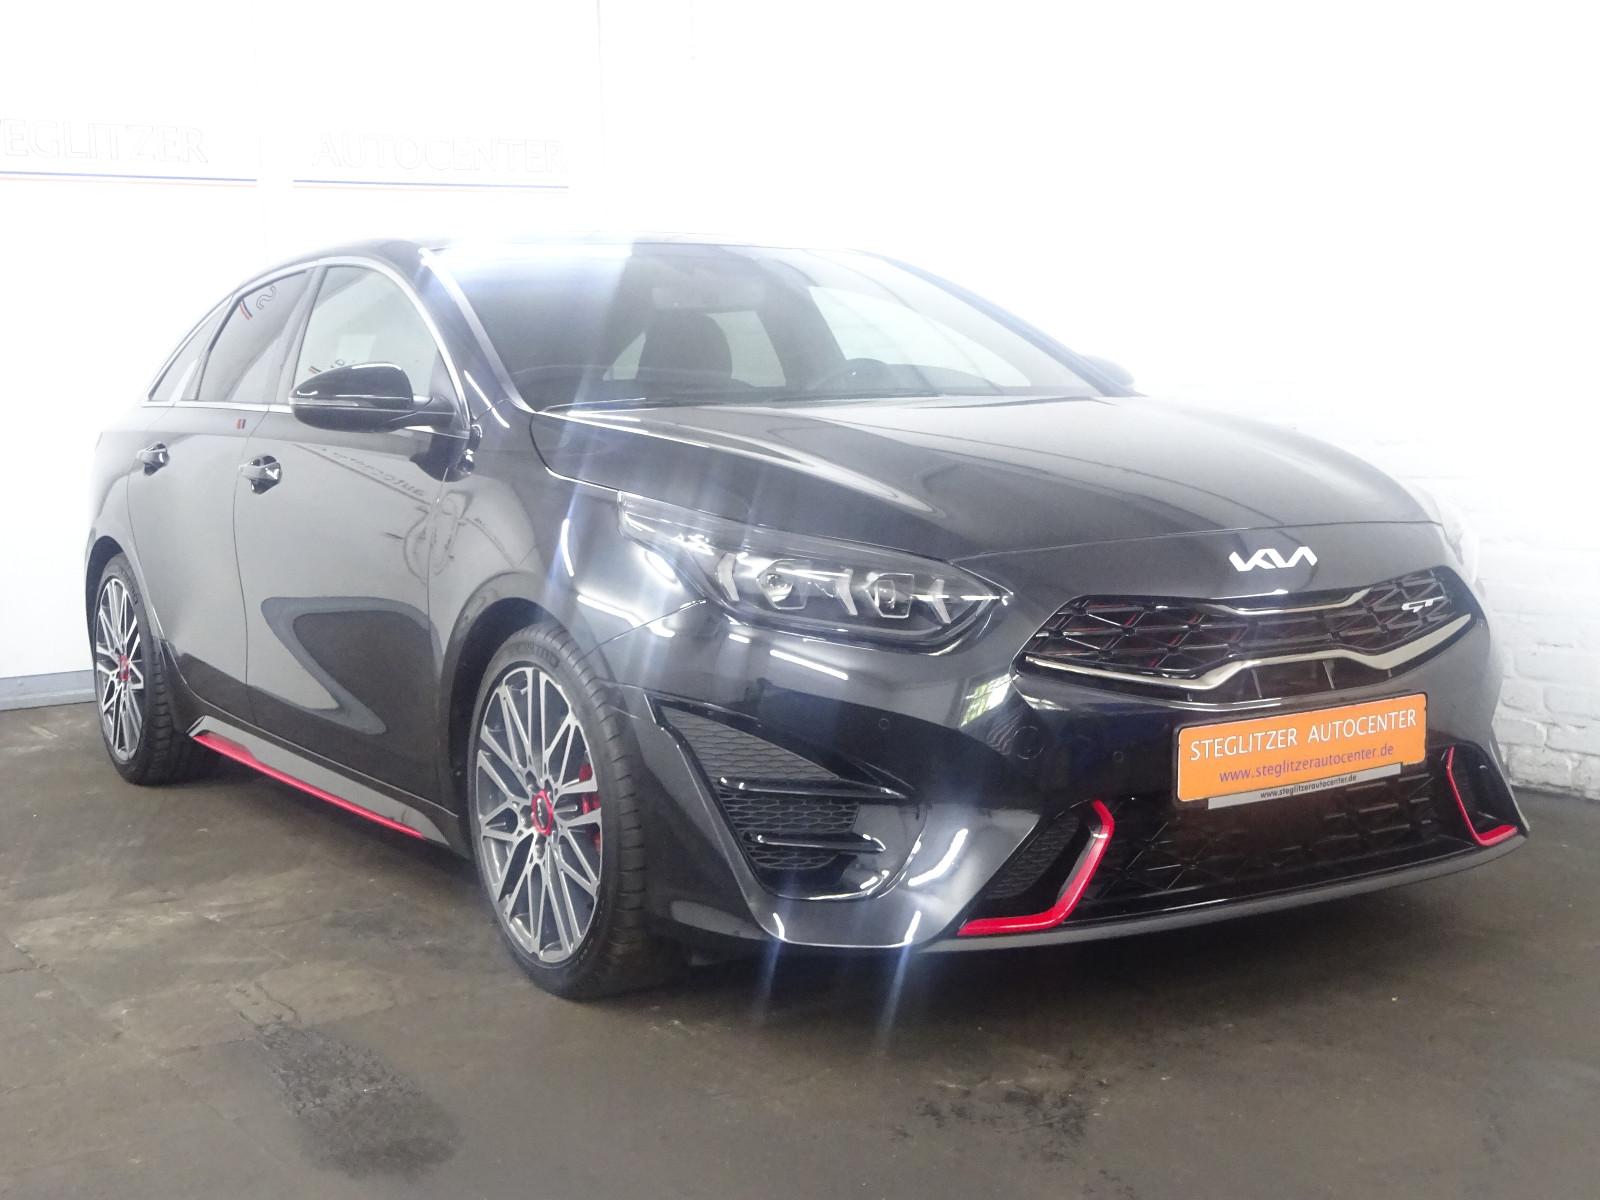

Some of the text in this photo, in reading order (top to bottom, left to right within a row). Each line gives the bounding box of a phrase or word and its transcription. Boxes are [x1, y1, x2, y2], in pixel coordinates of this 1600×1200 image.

[0, 117, 568, 174] EGLITZER AUTOCENTER
[1228, 546, 1318, 572] KIA
[1401, 595, 1446, 614] GT
[1190, 708, 1417, 761] STEGLITZER AUTOCENTER
[1219, 742, 1395, 783] www.steglitzerautocenter.de
[1259, 773, 1358, 799] www.steglitzerautocenter.de
